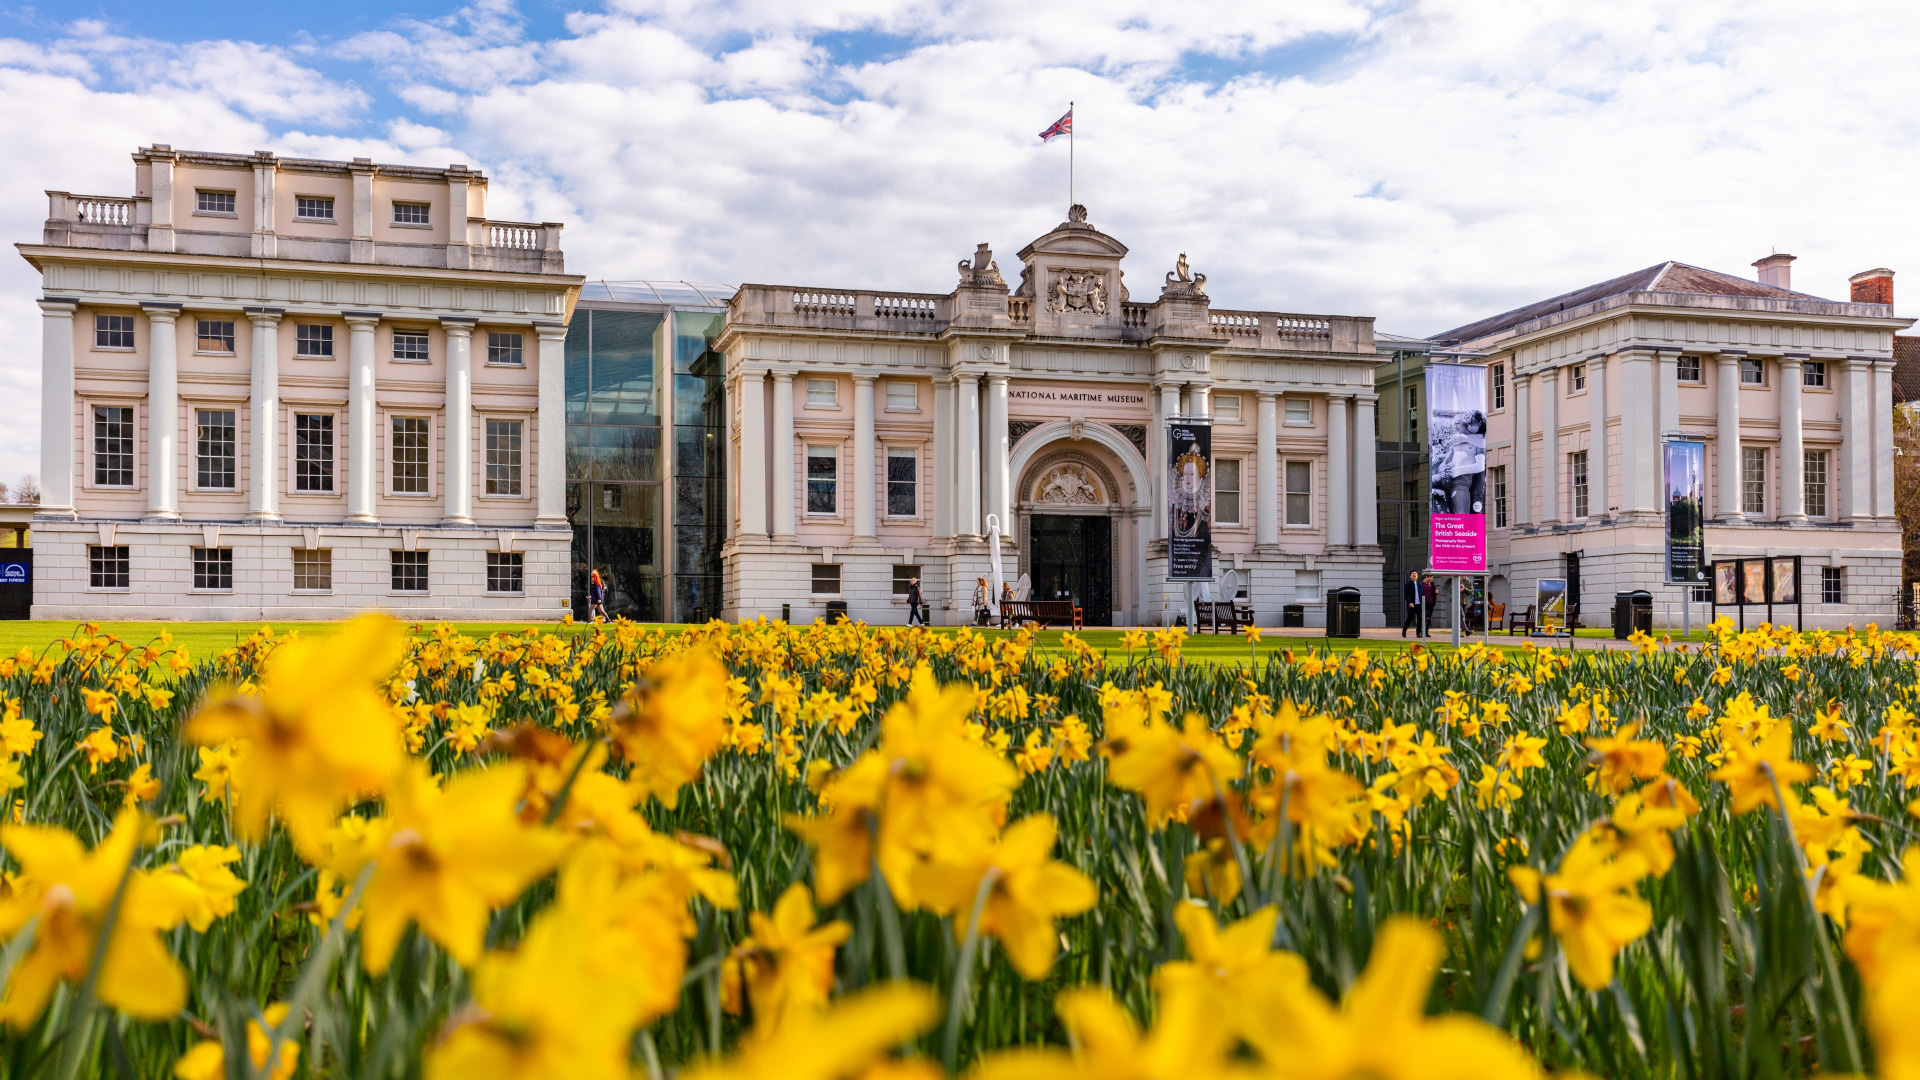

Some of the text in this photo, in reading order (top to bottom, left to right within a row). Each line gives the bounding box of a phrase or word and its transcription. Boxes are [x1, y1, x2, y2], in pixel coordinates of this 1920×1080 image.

[1009, 391, 1144, 403] NATIONAL MARITIME MUSEUM
